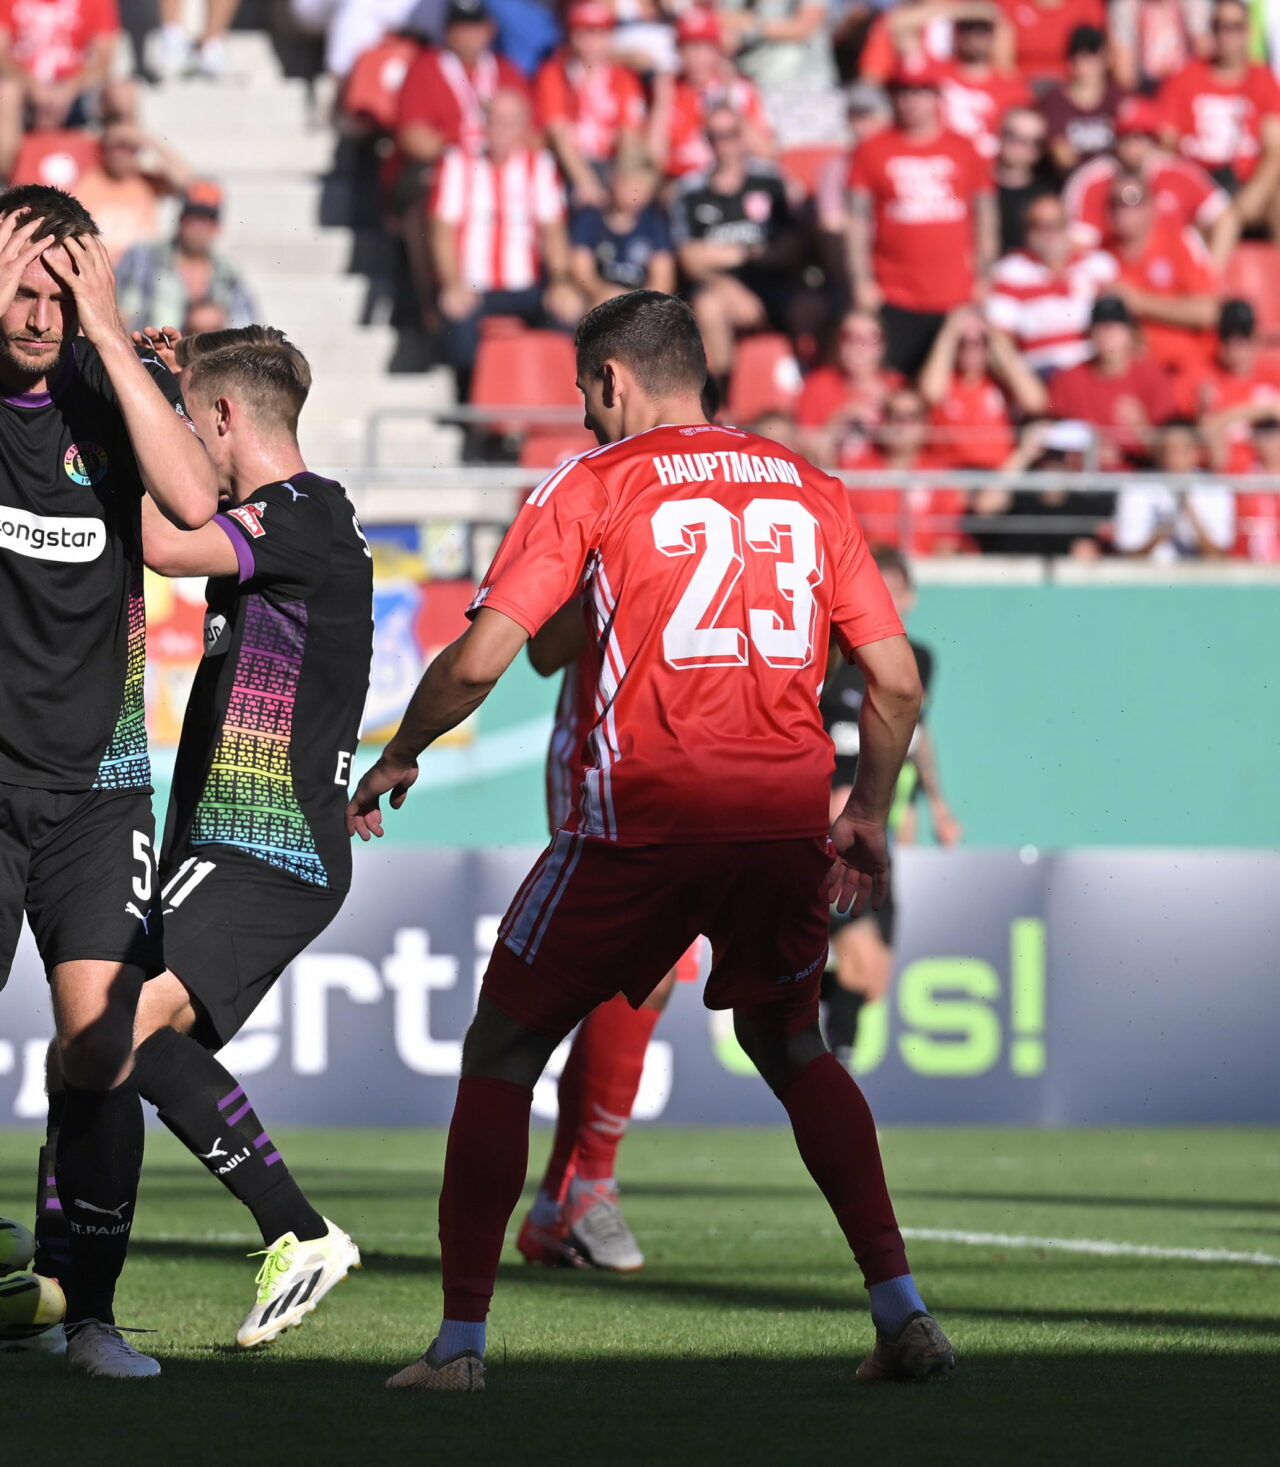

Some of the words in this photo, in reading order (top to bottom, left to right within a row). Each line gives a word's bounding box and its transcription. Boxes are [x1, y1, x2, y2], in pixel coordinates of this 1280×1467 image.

[652, 451, 803, 488] HAUPTMANN
[650, 497, 824, 671] 23
[132, 829, 152, 901] 5
[160, 856, 217, 908] 11
[214, 1146, 251, 1175] AULI
